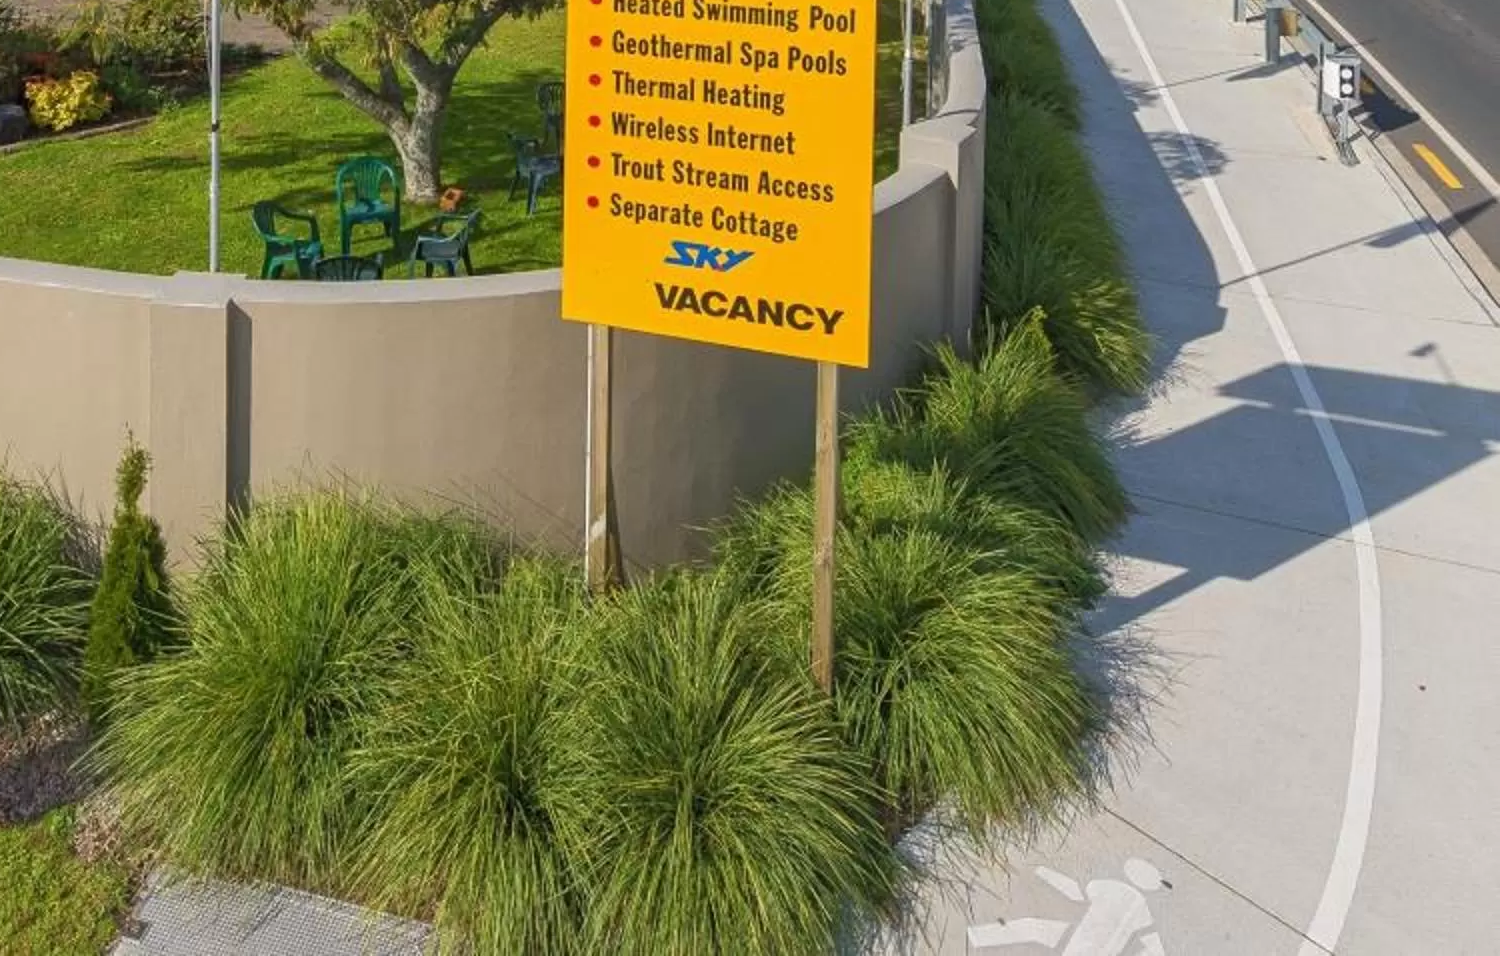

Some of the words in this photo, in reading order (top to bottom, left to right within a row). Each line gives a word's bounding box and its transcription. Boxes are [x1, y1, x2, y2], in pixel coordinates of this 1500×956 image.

[809, 5, 856, 34] Pool
[612, 29, 732, 65] Geothermal
[740, 41, 779, 73] Spa
[787, 46, 847, 76] Pools
[611, 70, 695, 102] Thermal
[703, 79, 785, 117] Heating
[611, 111, 699, 145] Wireless
[707, 122, 795, 155] Internet
[611, 152, 665, 182] Trout
[672, 159, 749, 193] Stream
[757, 170, 834, 203] Access
[610, 193, 703, 228] Separate
[711, 206, 798, 243] Cottage
[663, 239, 755, 273] SKY
[654, 282, 845, 335] VACANCY
